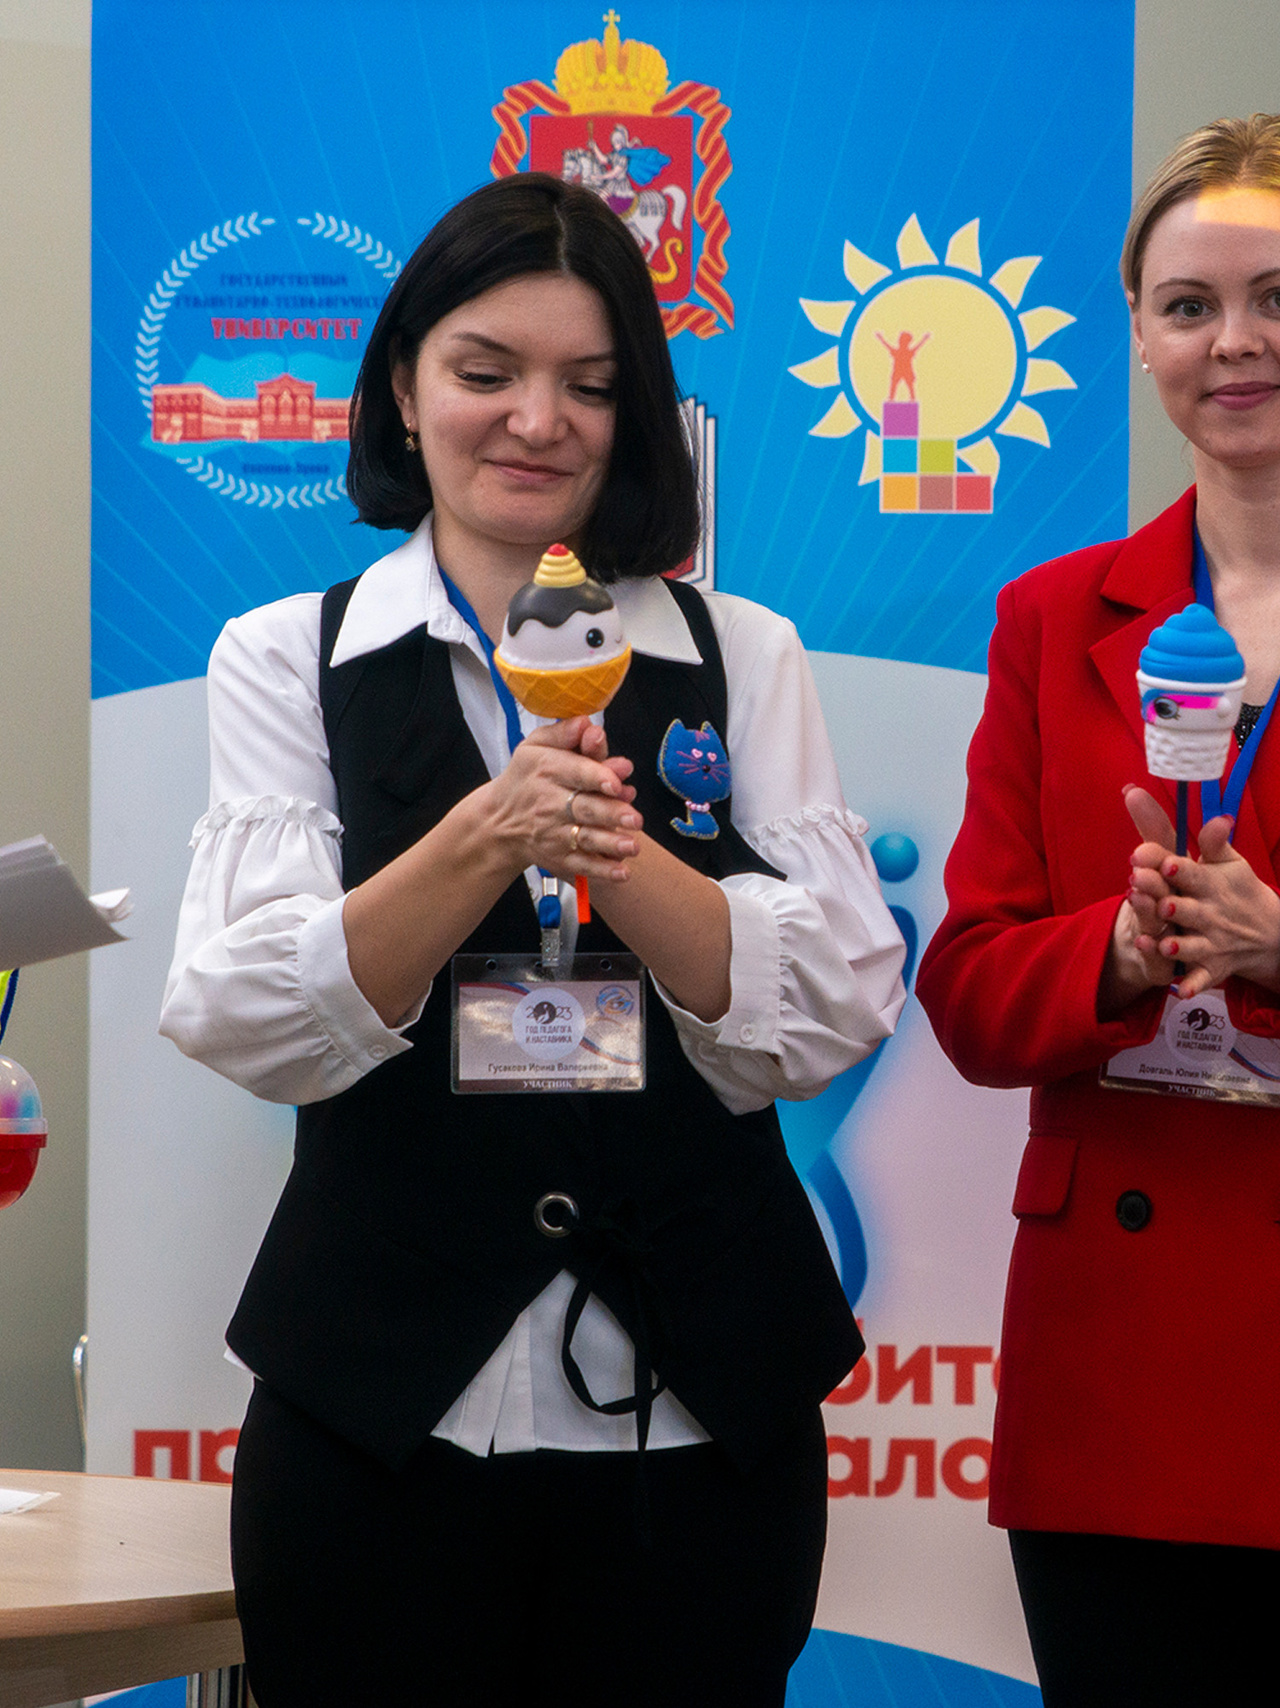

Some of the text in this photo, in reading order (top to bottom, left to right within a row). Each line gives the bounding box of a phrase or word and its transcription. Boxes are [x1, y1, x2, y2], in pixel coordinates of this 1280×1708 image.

[211, 317, 362, 339] УНИВЕРСИТЕТ
[526, 1025, 572, 1034] ГОД ПЕДАГОГА
[532, 1035, 572, 1044] НАСТАВНИКА
[1177, 1030, 1223, 1043] ГОД ПЕДАГОГА
[1182, 1041, 1221, 1052] НАСТАВНИКА
[488, 1062, 527, 1075] Гусакова
[529, 1062, 555, 1073] Ирина
[1139, 1063, 1174, 1076] Довгаль
[1176, 1067, 1199, 1078] Юлия
[523, 1080, 573, 1090] УЧАСТНИК
[1168, 1084, 1216, 1097] УЧАСТНИК
